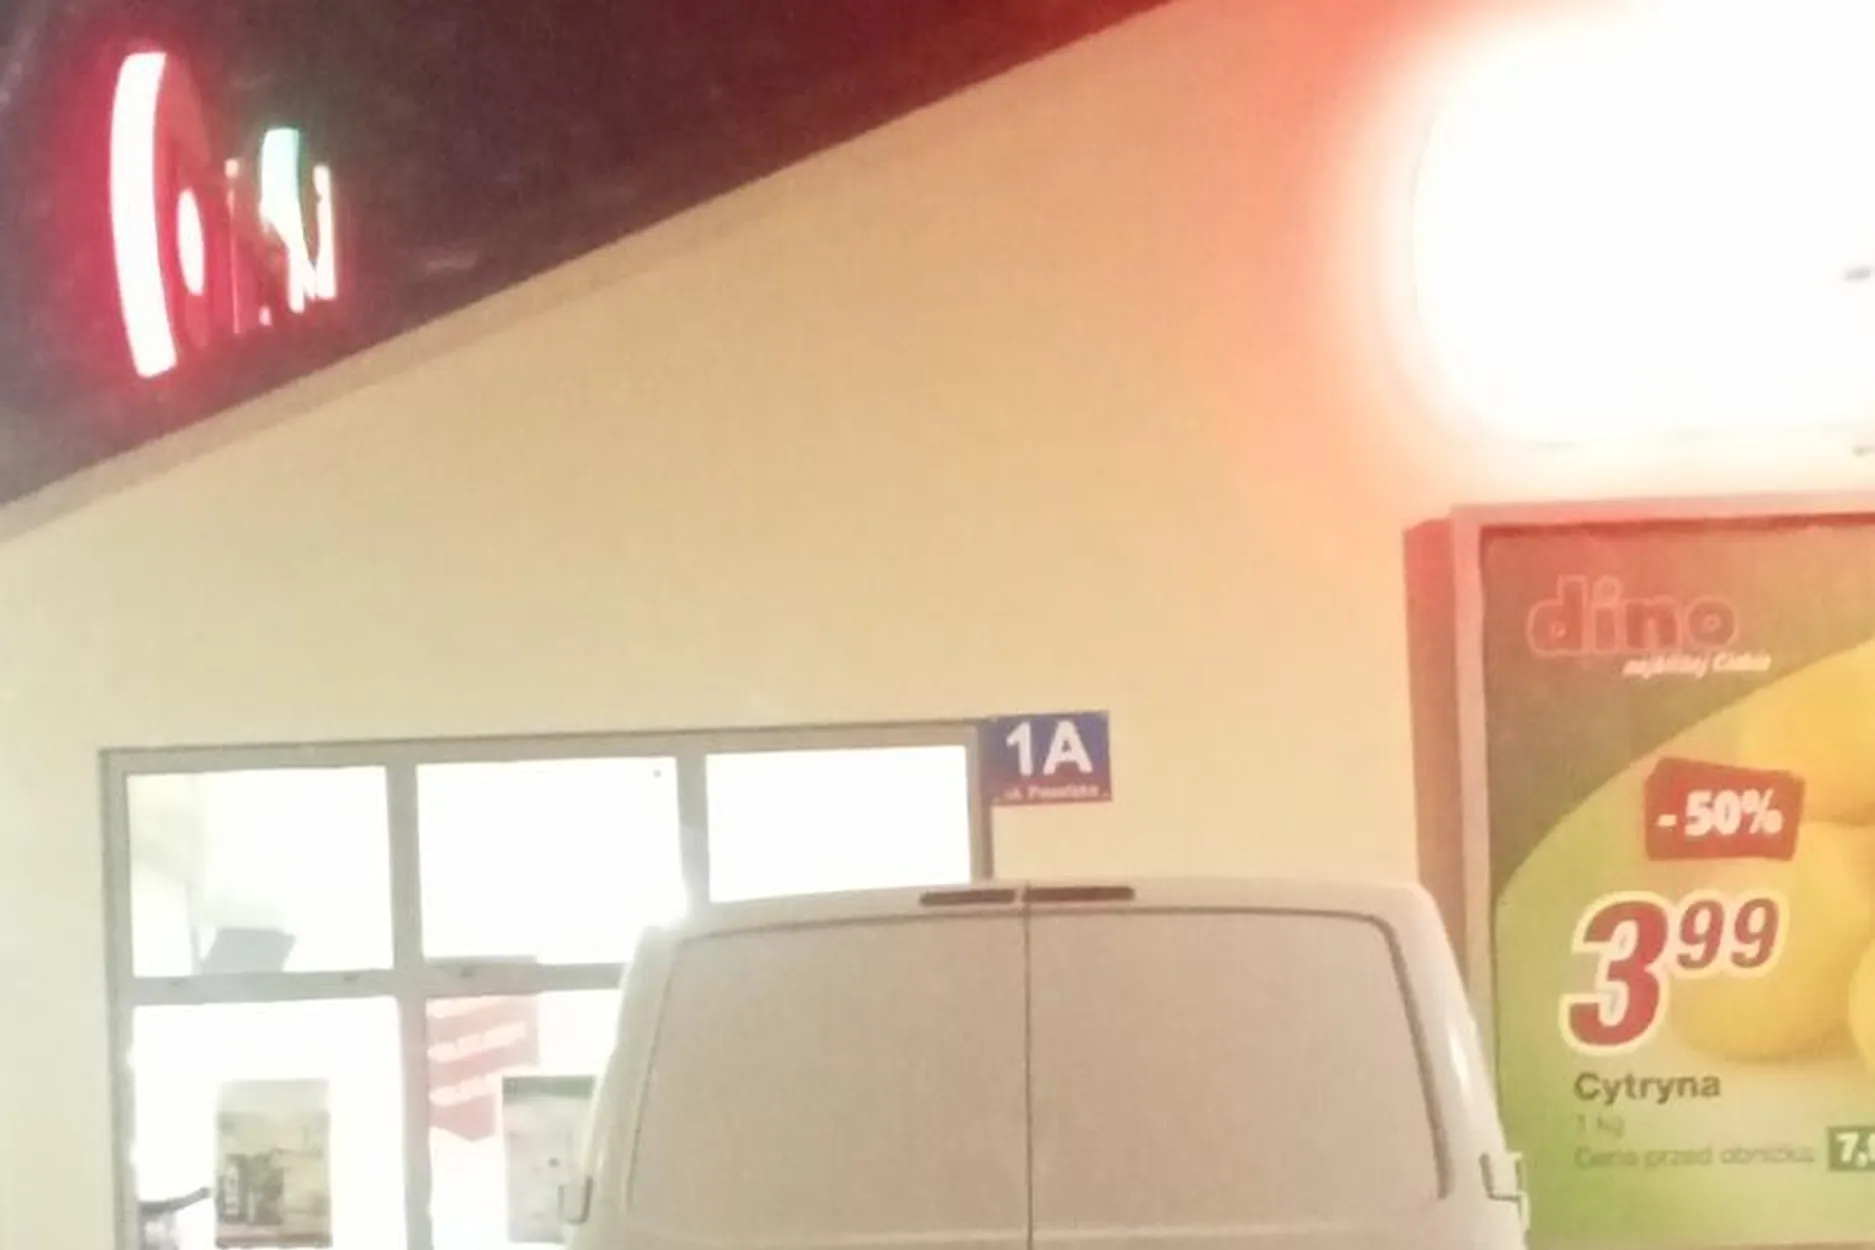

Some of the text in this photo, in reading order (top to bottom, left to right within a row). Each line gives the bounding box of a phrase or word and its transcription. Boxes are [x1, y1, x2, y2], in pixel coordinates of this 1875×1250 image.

[1527, 575, 1738, 656] dino
[1006, 720, 1093, 777] 1A
[1574, 1072, 1721, 1105] Cytryna
